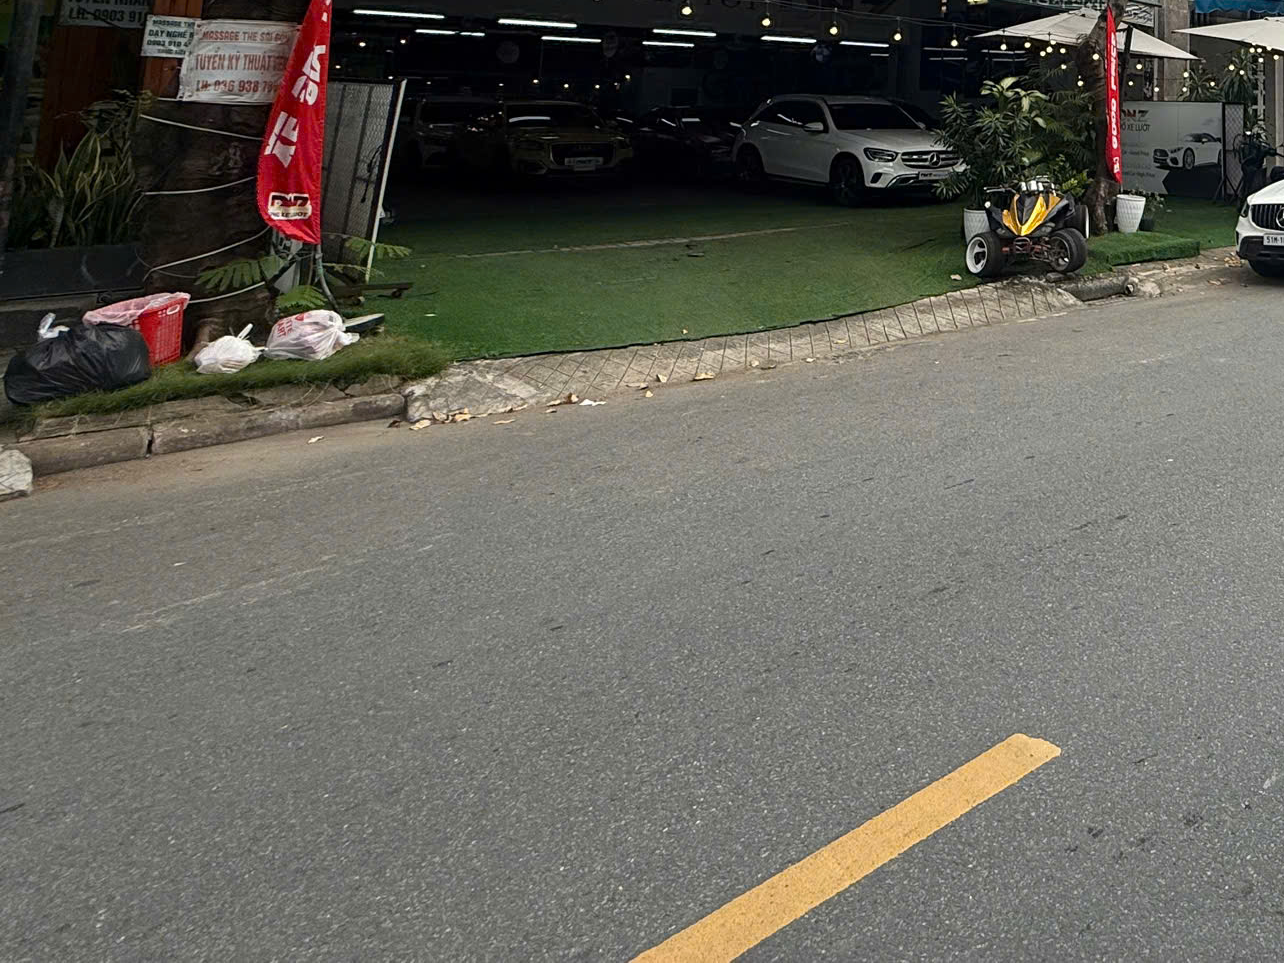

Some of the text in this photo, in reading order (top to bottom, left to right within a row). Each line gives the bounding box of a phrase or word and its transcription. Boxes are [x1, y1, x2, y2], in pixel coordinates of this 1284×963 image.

[202, 30, 240, 42] MASSAGE
[242, 32, 258, 43] THE
[238, 80, 260, 93] 938
